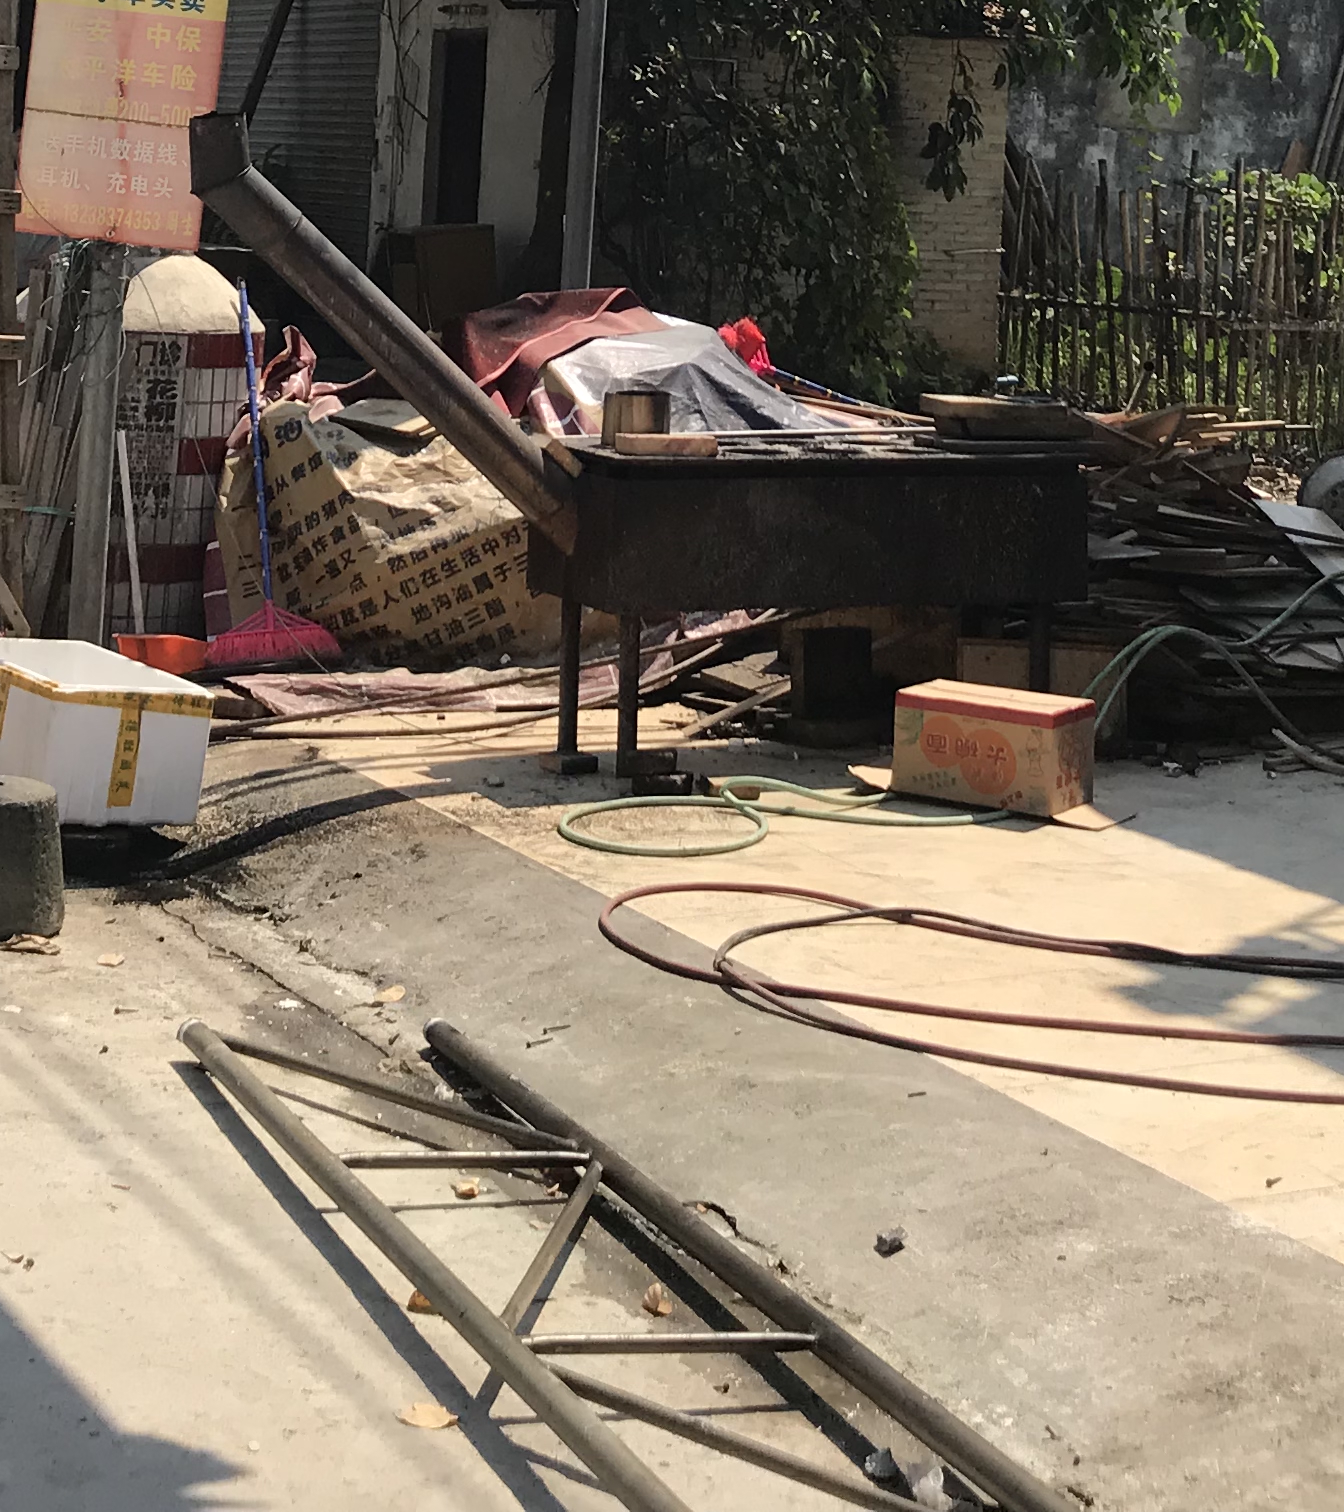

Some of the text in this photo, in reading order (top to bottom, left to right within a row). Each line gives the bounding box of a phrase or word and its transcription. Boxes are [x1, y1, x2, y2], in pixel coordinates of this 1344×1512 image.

[146, 24, 202, 53] 中保
[60, 59, 197, 92] 平洋车险
